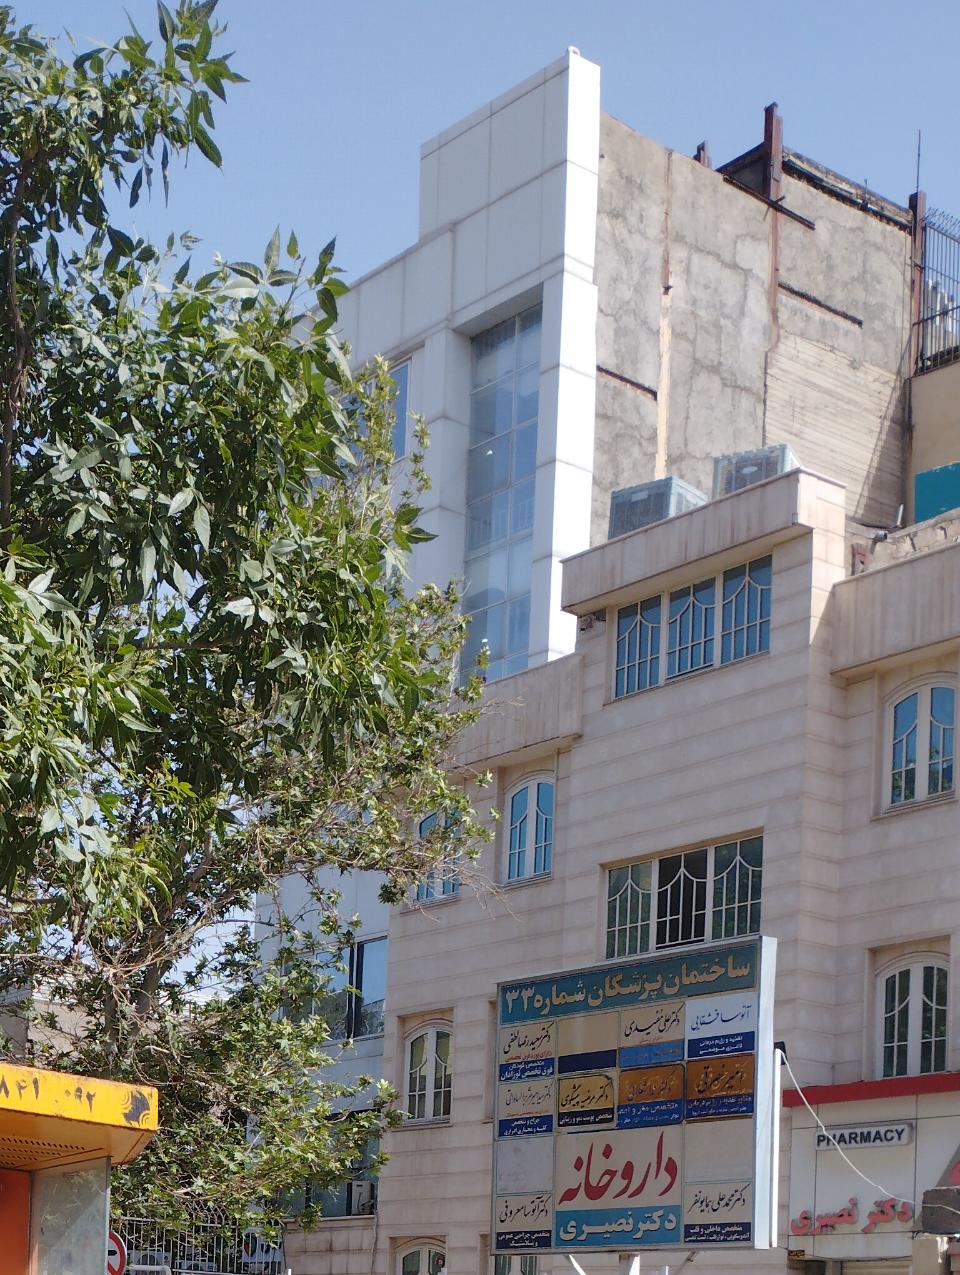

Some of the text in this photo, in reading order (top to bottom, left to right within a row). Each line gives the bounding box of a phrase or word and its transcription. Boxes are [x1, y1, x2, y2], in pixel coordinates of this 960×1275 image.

[588, 972, 663, 1006] پزشکان
[663, 955, 750, 995] ساختمان
[534, 981, 586, 1014] شماره
[816, 1128, 904, 1147] PHARMACY
[558, 1130, 678, 1206] داروخانه
[559, 1209, 677, 1242] دکتر نصیری
[790, 1196, 913, 1236] دکتر نصیری
